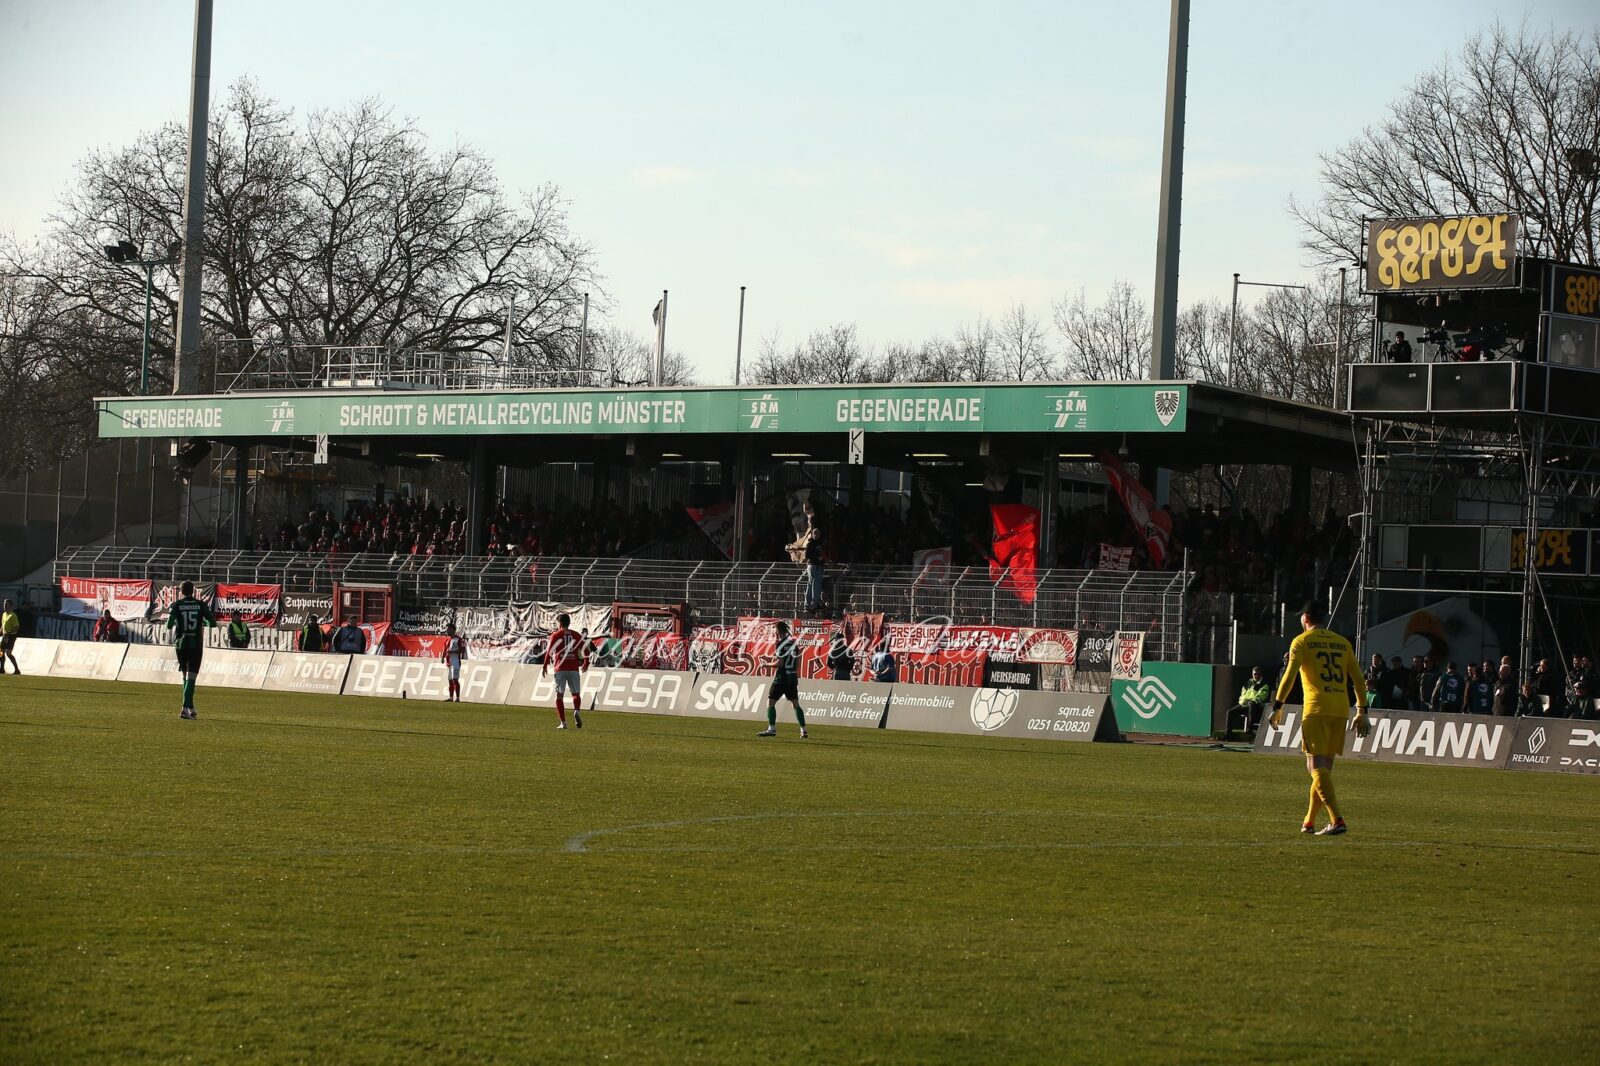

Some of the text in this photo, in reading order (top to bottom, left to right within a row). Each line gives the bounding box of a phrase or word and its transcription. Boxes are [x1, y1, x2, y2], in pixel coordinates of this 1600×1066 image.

[1565, 275, 1600, 296] con
[271, 407, 295, 419] SRM
[340, 396, 686, 427] SCHROTT & METALLRECYCLING MÜNSTER
[750, 401, 779, 414] SRM
[836, 398, 981, 423] GEGENGERADE
[1055, 399, 1087, 412] SRM
[122, 406, 223, 429] GEGENGERADE
[851, 430, 863, 453] K
[284, 596, 334, 611] Supporters
[181, 611, 198, 631] 15
[239, 662, 251, 676] IM
[1315, 651, 1345, 683] 35
[990, 670, 1031, 685] MERSEBURG
[531, 667, 682, 710] BRESA
[694, 679, 766, 713] SQM
[798, 690, 835, 703] machen
[837, 690, 857, 704] Ihre
[805, 707, 827, 717] zum
[1057, 705, 1095, 718] sqm.de
[1027, 718, 1091, 733] 0251 620820
[1511, 753, 1551, 764] RENAULT
